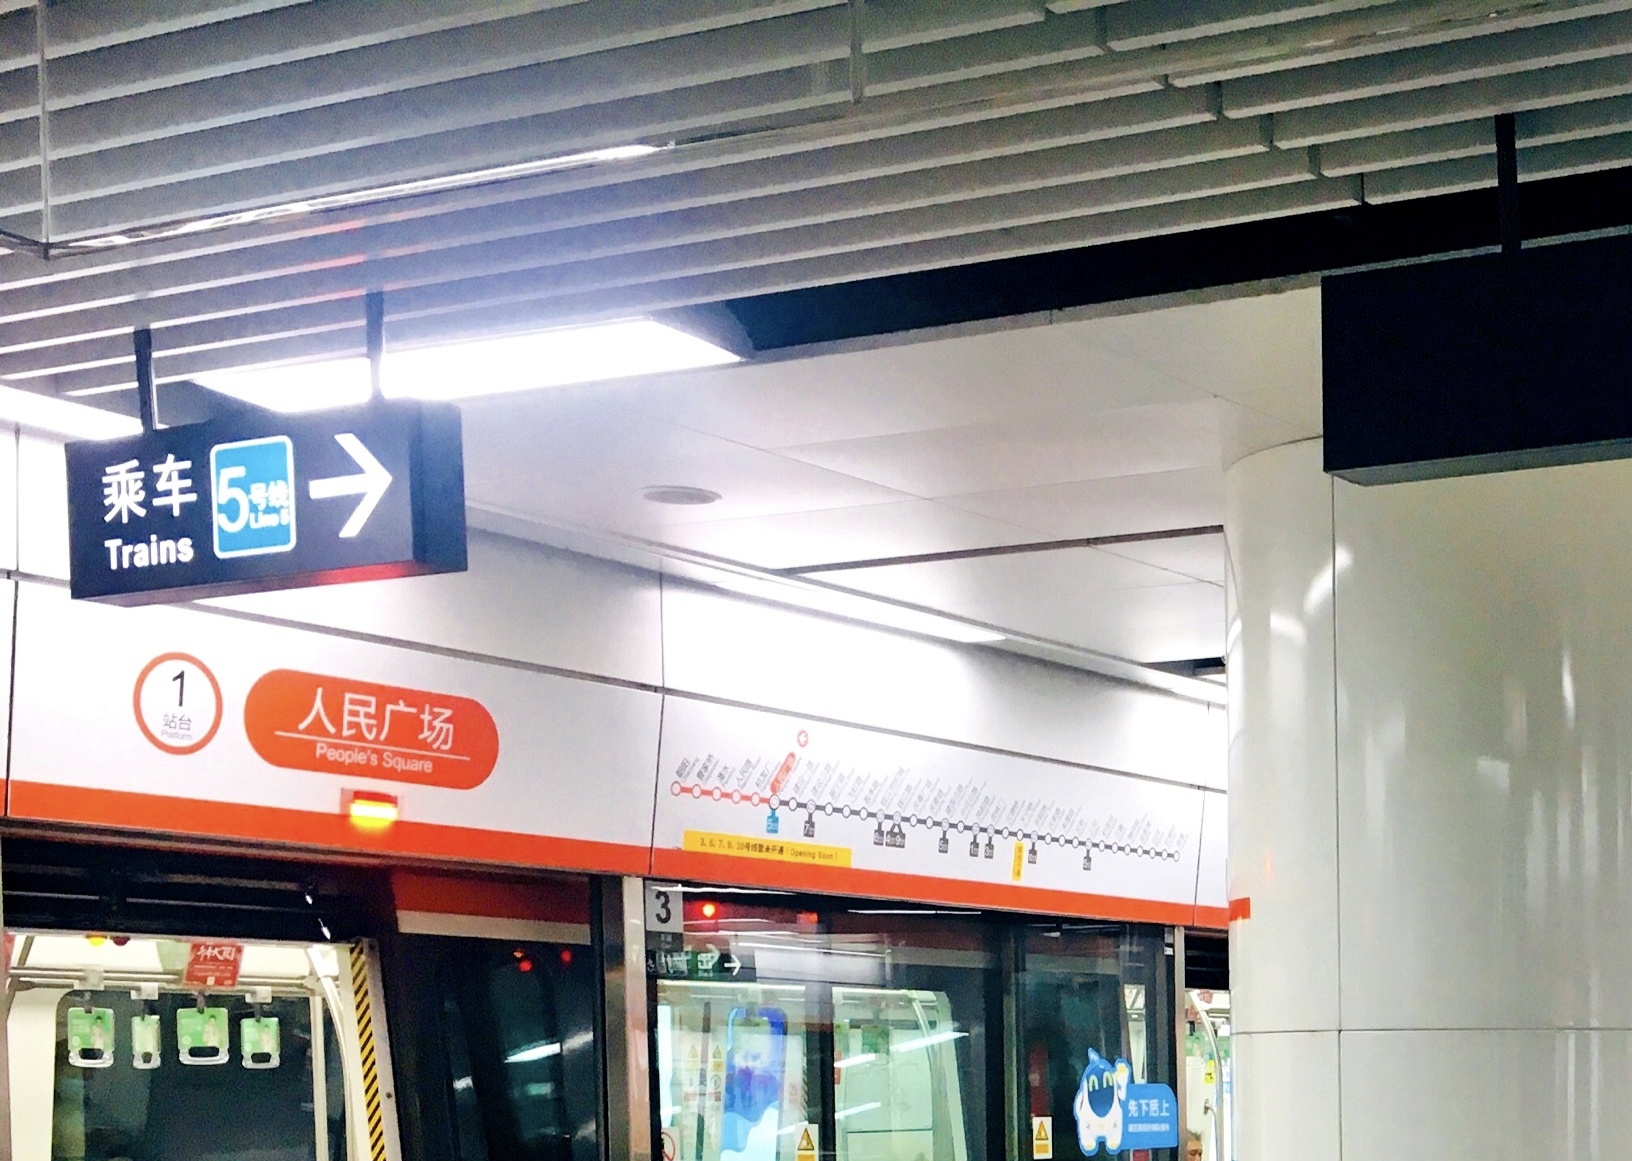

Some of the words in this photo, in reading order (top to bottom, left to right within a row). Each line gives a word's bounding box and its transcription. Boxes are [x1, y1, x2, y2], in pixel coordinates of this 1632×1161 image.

[101, 453, 198, 524] 乘车
[104, 534, 194, 570] Trains
[172, 670, 185, 707] 1
[163, 713, 192, 731] 站台
[298, 687, 454, 750] 人民广场
[315, 742, 378, 766] People's
[382, 752, 433, 773] Square
[655, 891, 671, 924] 3
[1127, 1100, 1170, 1117] 先下后上
